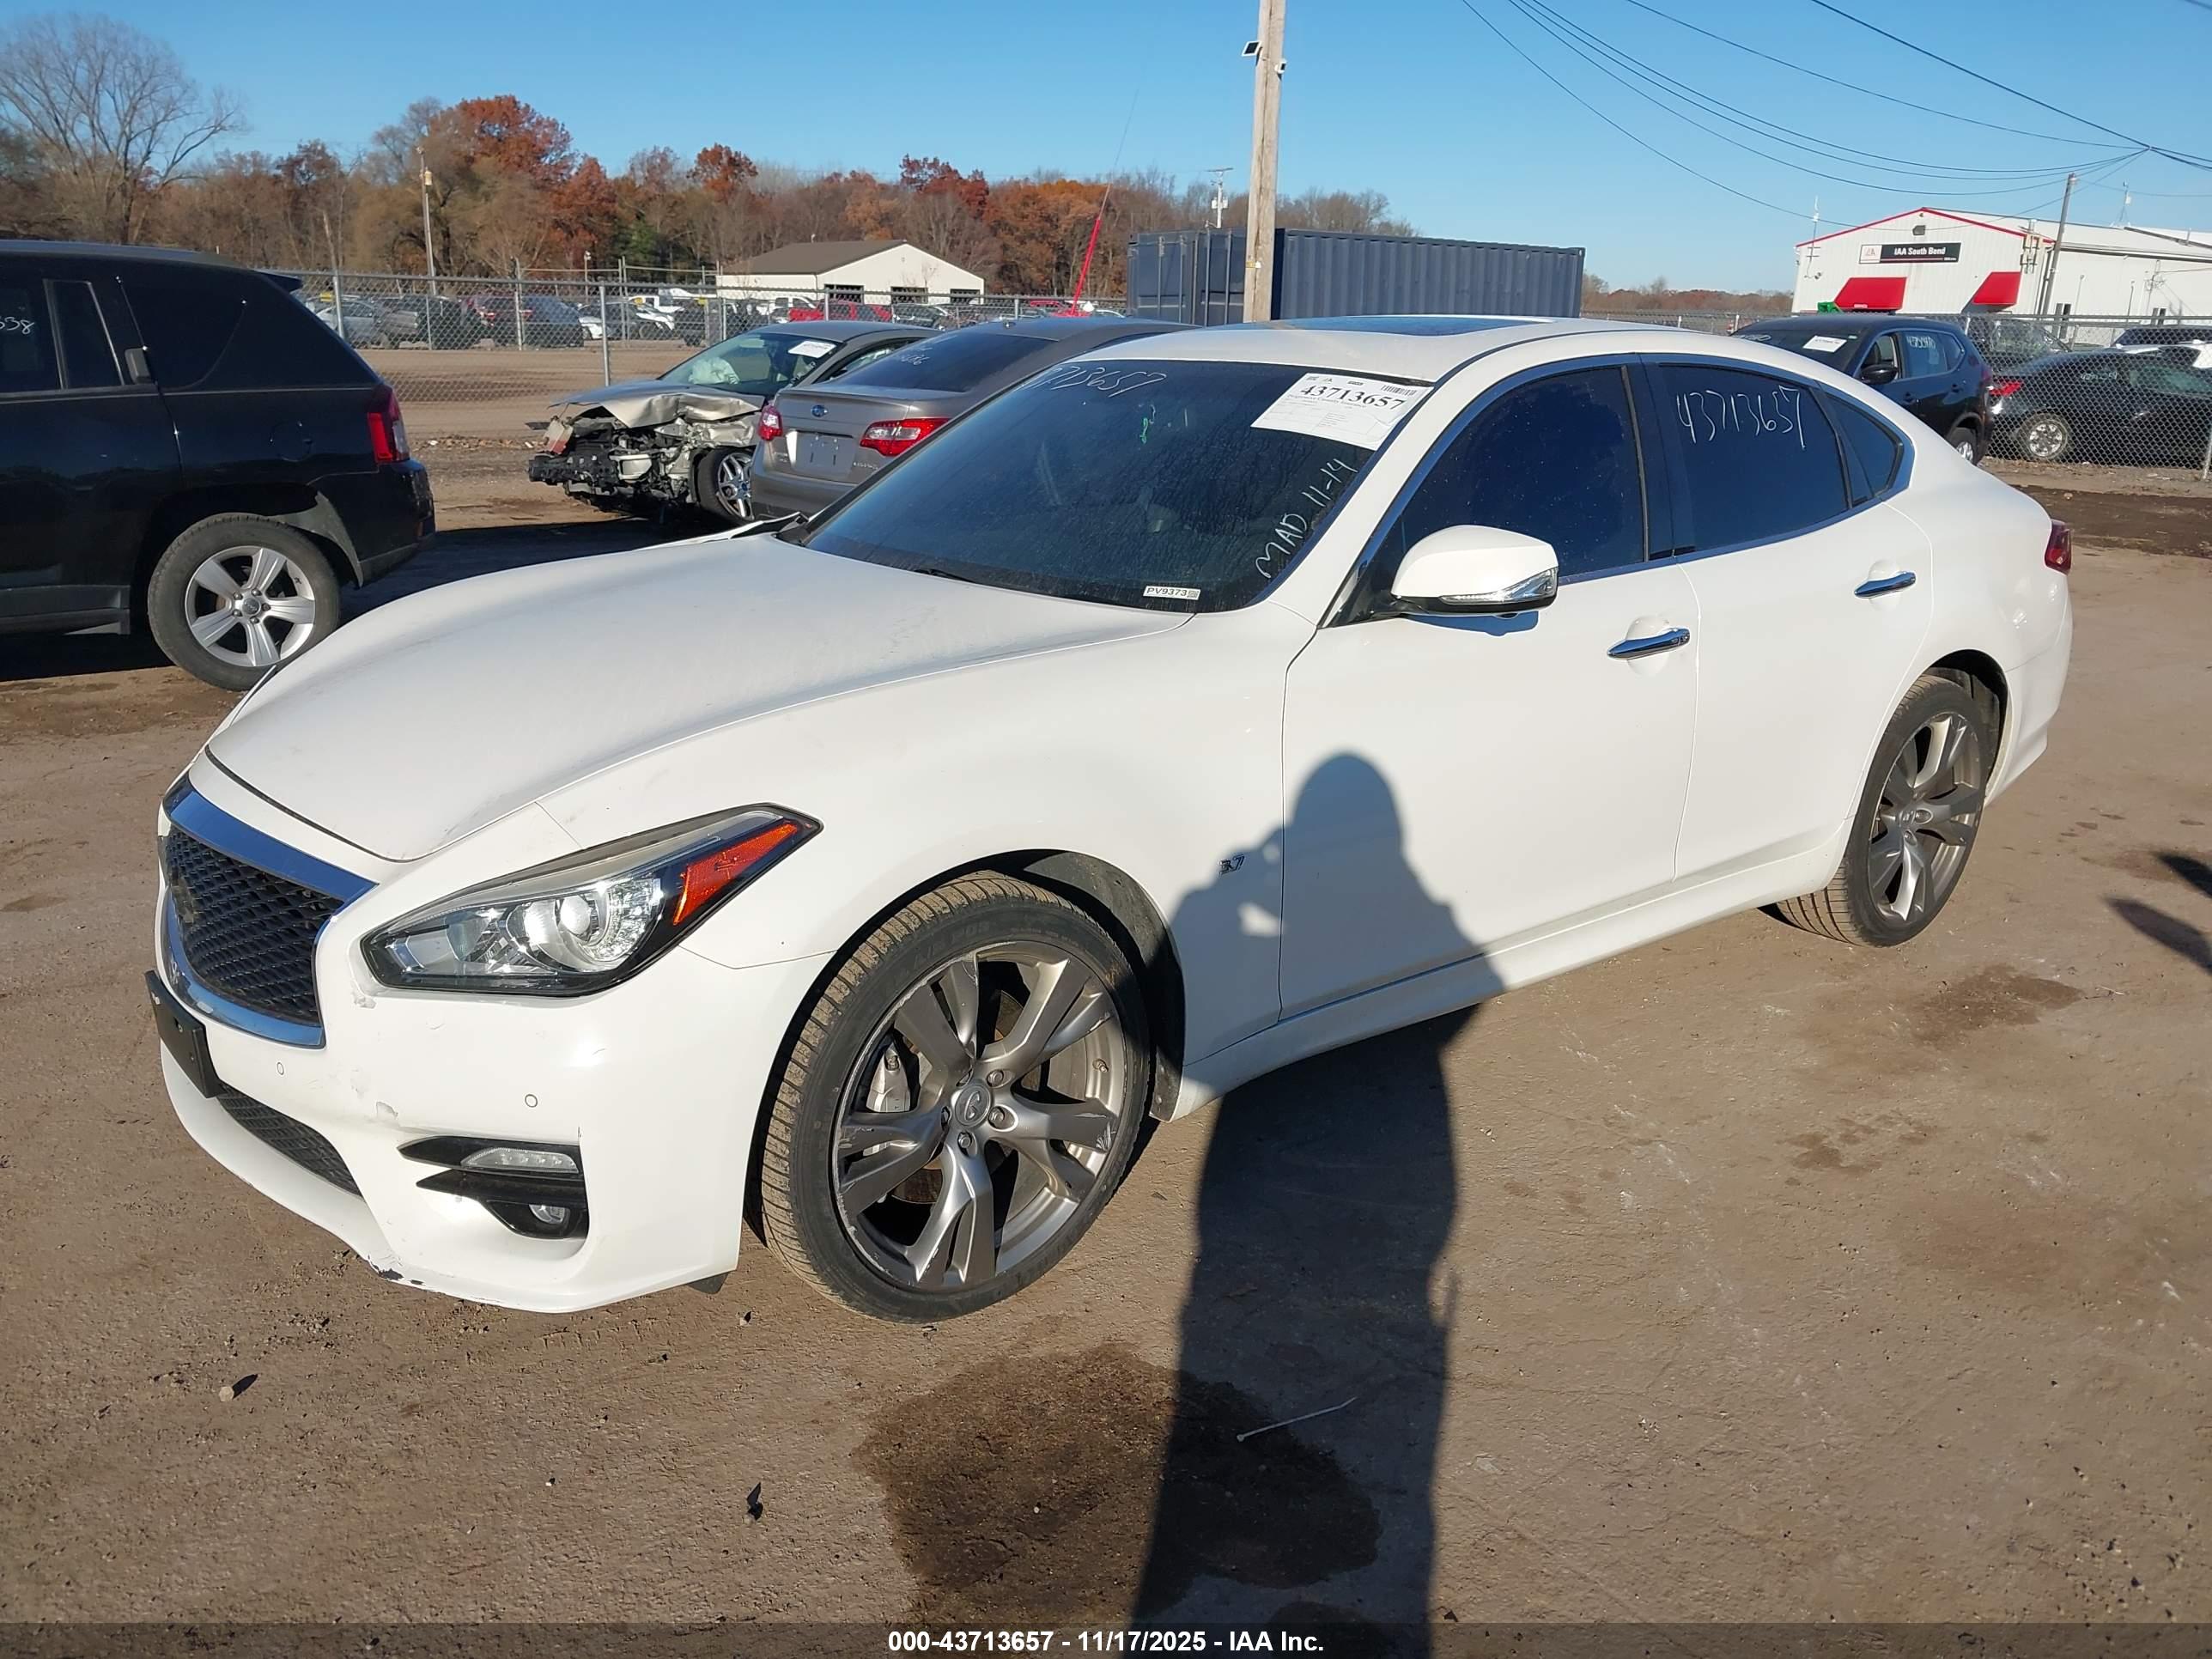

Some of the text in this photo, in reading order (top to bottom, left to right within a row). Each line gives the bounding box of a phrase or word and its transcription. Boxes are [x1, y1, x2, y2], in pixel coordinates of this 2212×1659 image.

[1929, 246, 1947, 255] Bend
[1300, 385, 1407, 410] 43713657
[1676, 385, 1807, 451] 43713657
[1146, 587, 1188, 597] PV9373
